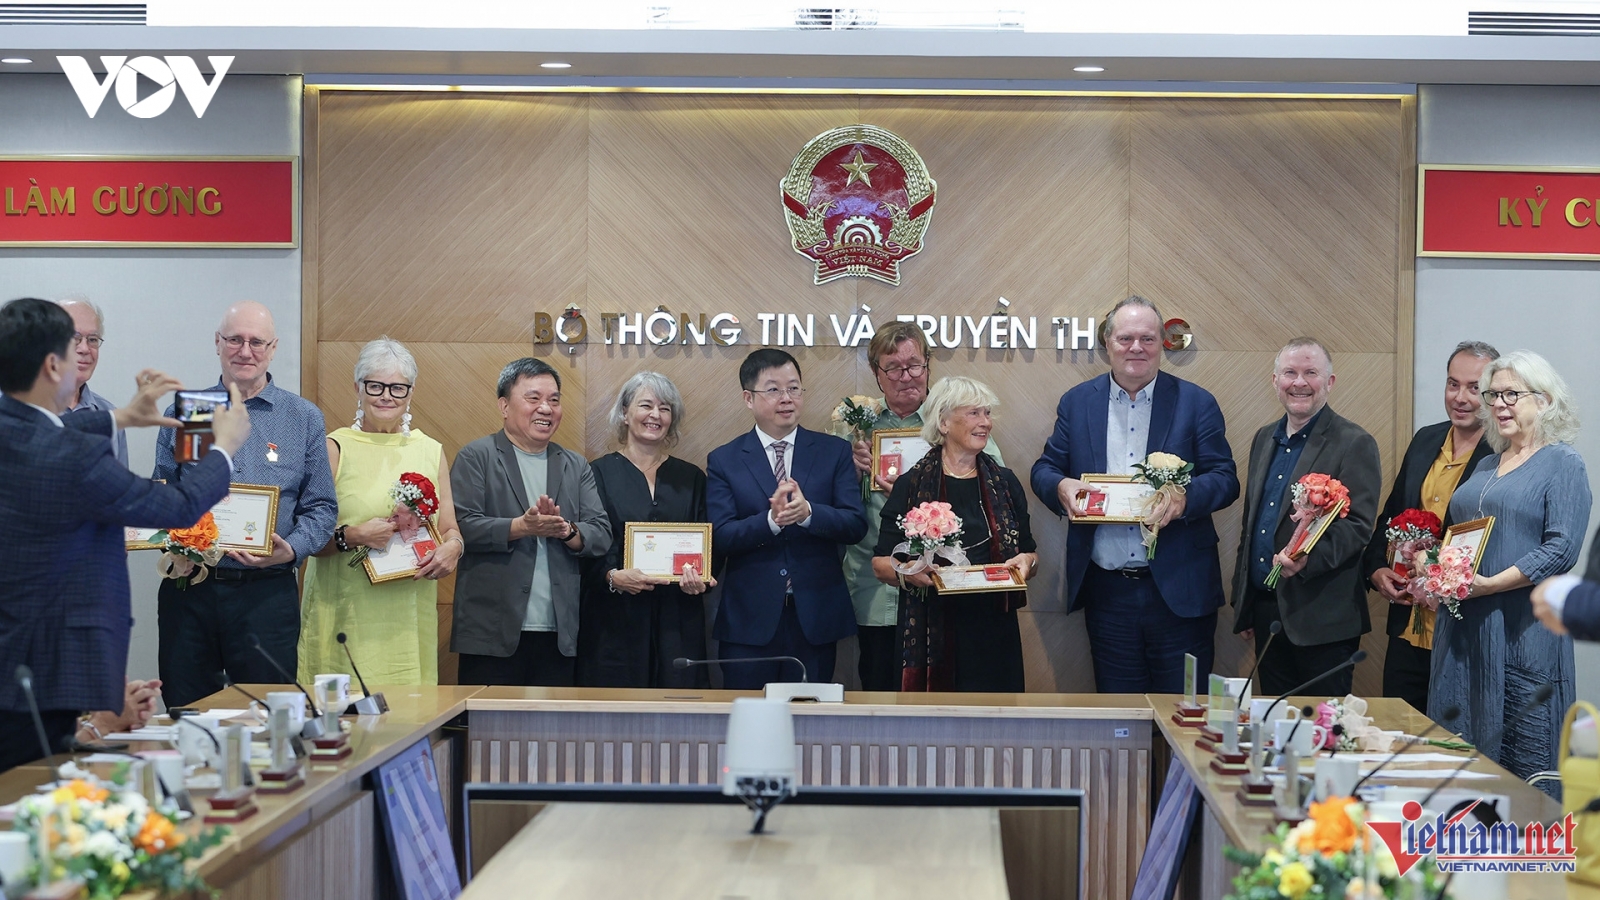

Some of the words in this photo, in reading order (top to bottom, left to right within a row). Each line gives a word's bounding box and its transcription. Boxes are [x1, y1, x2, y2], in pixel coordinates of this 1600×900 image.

[5, 177, 76, 216] LÀM
[92, 182, 222, 216] GƯƠNG
[1499, 185, 1549, 226] KỶ
[1564, 197, 1600, 228] C
[859, 255, 884, 267] NAM
[534, 302, 588, 354] BỘ
[600, 304, 742, 346] THÔNG
[757, 312, 815, 347] TIN
[829, 303, 876, 347] VÀ
[1052, 312, 1193, 351] THG
